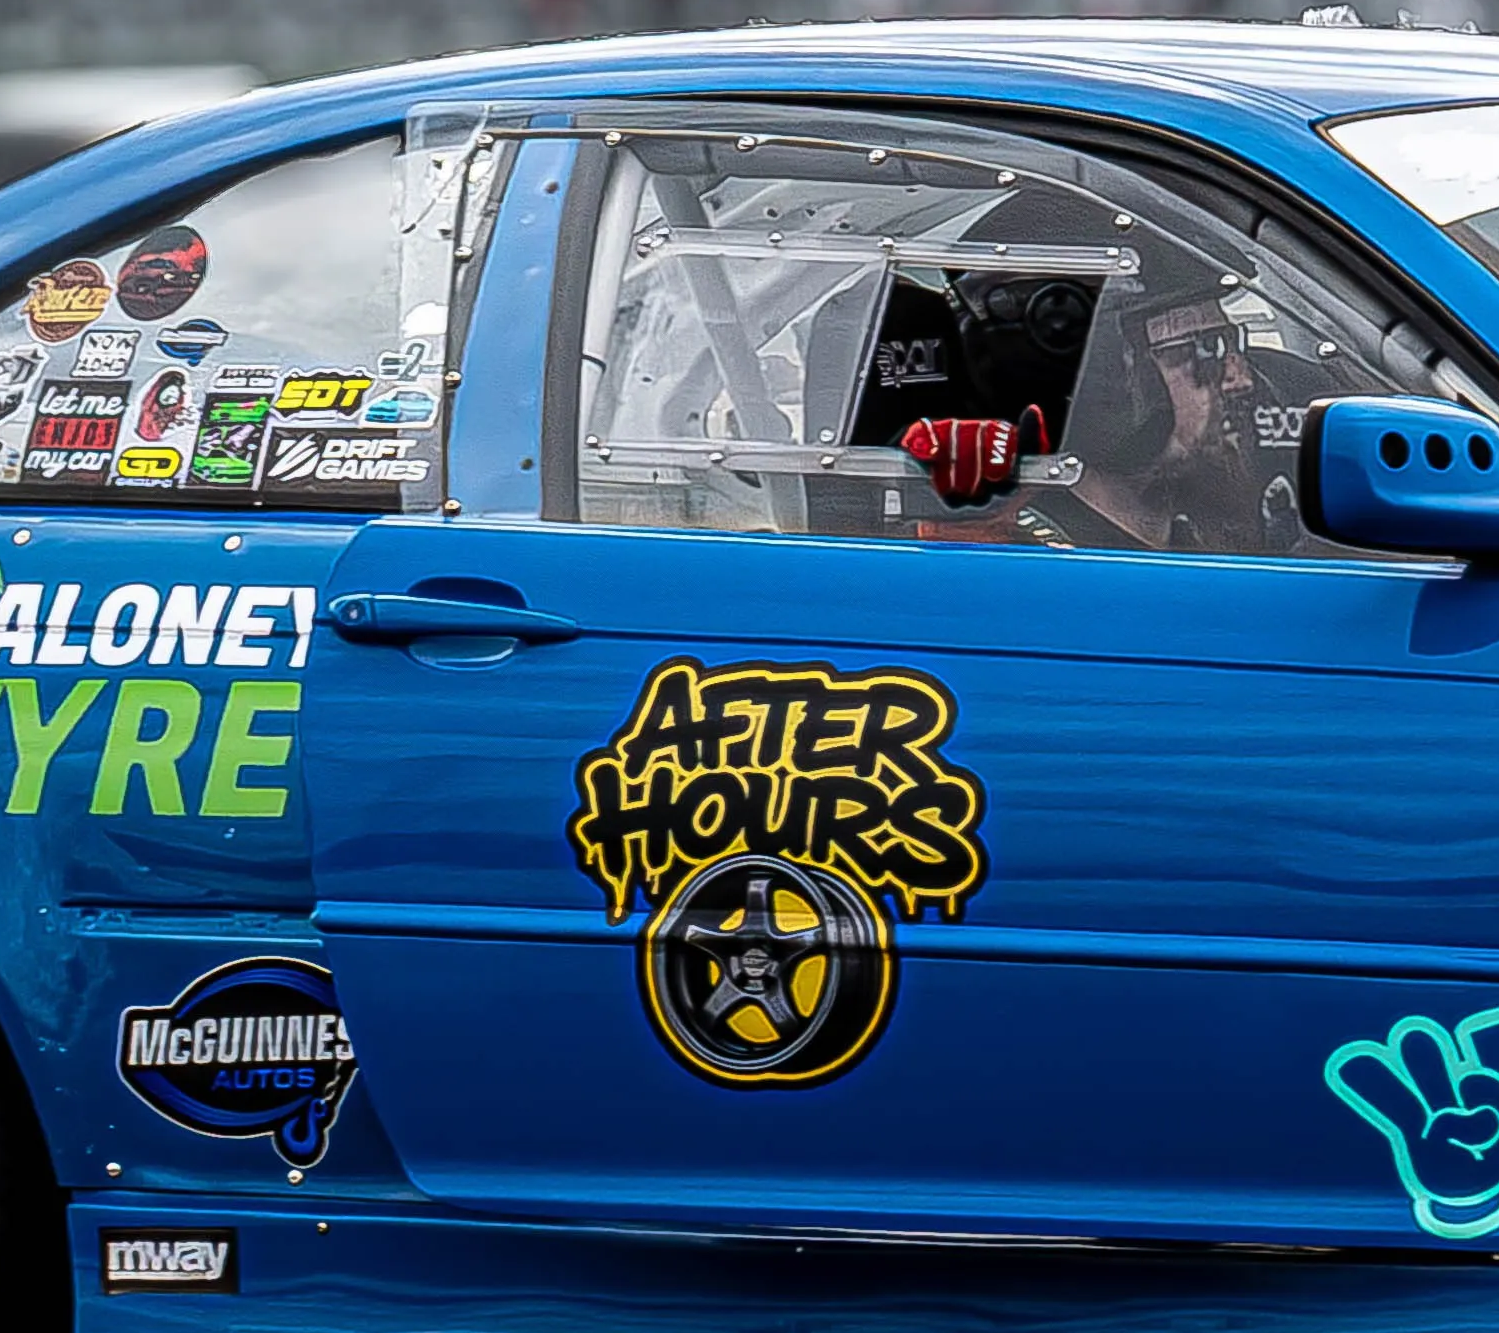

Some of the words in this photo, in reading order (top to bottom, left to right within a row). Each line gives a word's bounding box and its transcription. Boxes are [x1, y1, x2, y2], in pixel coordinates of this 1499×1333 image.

[77, 395, 124, 415] me
[321, 439, 417, 459] DRIFT
[315, 459, 430, 482] GAMES
[616, 664, 951, 778] AFTER
[575, 757, 981, 898] HOURS
[212, 1068, 316, 1090] AUTOS
[107, 1241, 229, 1280] mway
